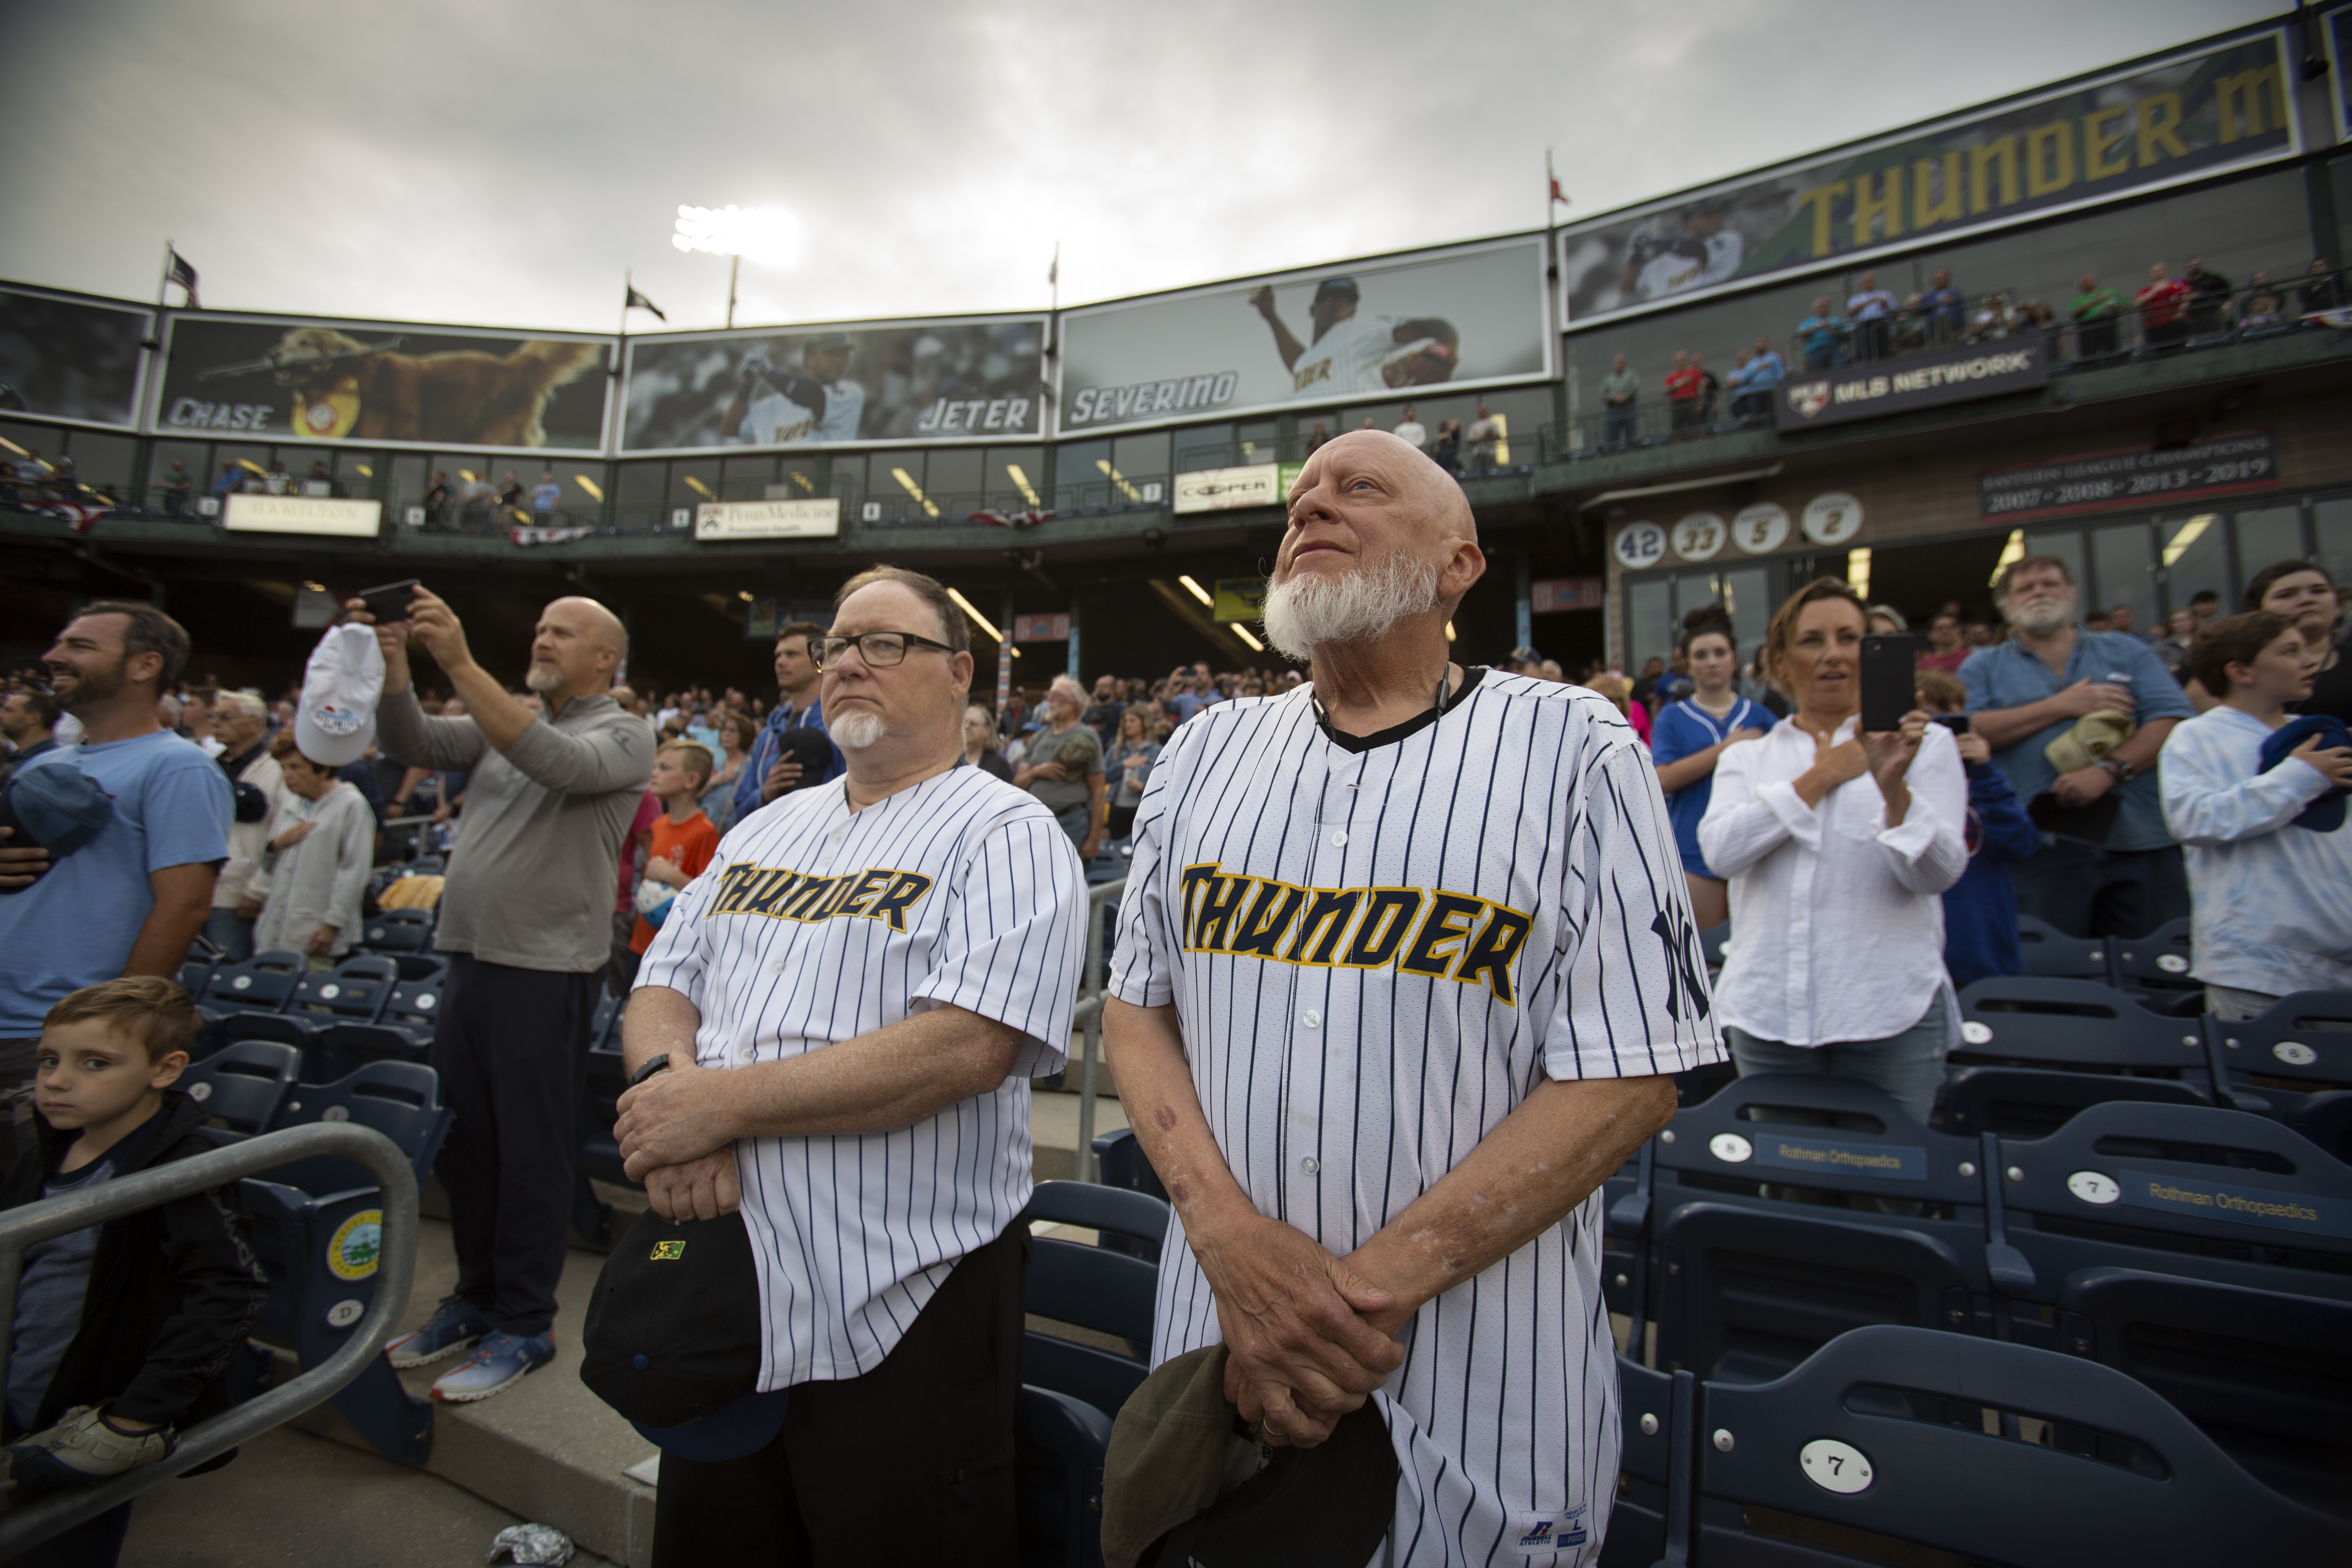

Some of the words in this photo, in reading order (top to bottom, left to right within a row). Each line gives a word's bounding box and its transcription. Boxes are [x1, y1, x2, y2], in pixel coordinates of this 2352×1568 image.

[1801, 90, 2189, 259] THUNDER
[1833, 375, 1891, 405] MLB
[1892, 351, 2034, 394] NETWORK
[1068, 370, 1239, 425] SEVERINO
[168, 395, 275, 432] CHASE
[918, 398, 1031, 432] JETER
[2126, 468, 2189, 494] 2013
[2203, 456, 2271, 484] 2019
[1750, 520, 1772, 545] 5
[1822, 511, 1844, 537] 2
[1621, 530, 1659, 559] 42
[1681, 529, 1717, 554] 33
[702, 861, 933, 934] THUNDER
[1179, 862, 1533, 1008] THUNDER
[1778, 1144, 1828, 1163] Rothman
[2086, 1181, 2100, 1193] 7
[2149, 1183, 2214, 1206] Rothman
[2216, 1193, 2318, 1221] Orthopaedics
[340, 1306, 352, 1319] D
[1828, 1455, 1844, 1476] 7
[1520, 1534, 1552, 1542] RUSSELL
[1572, 1519, 1581, 1531] L
